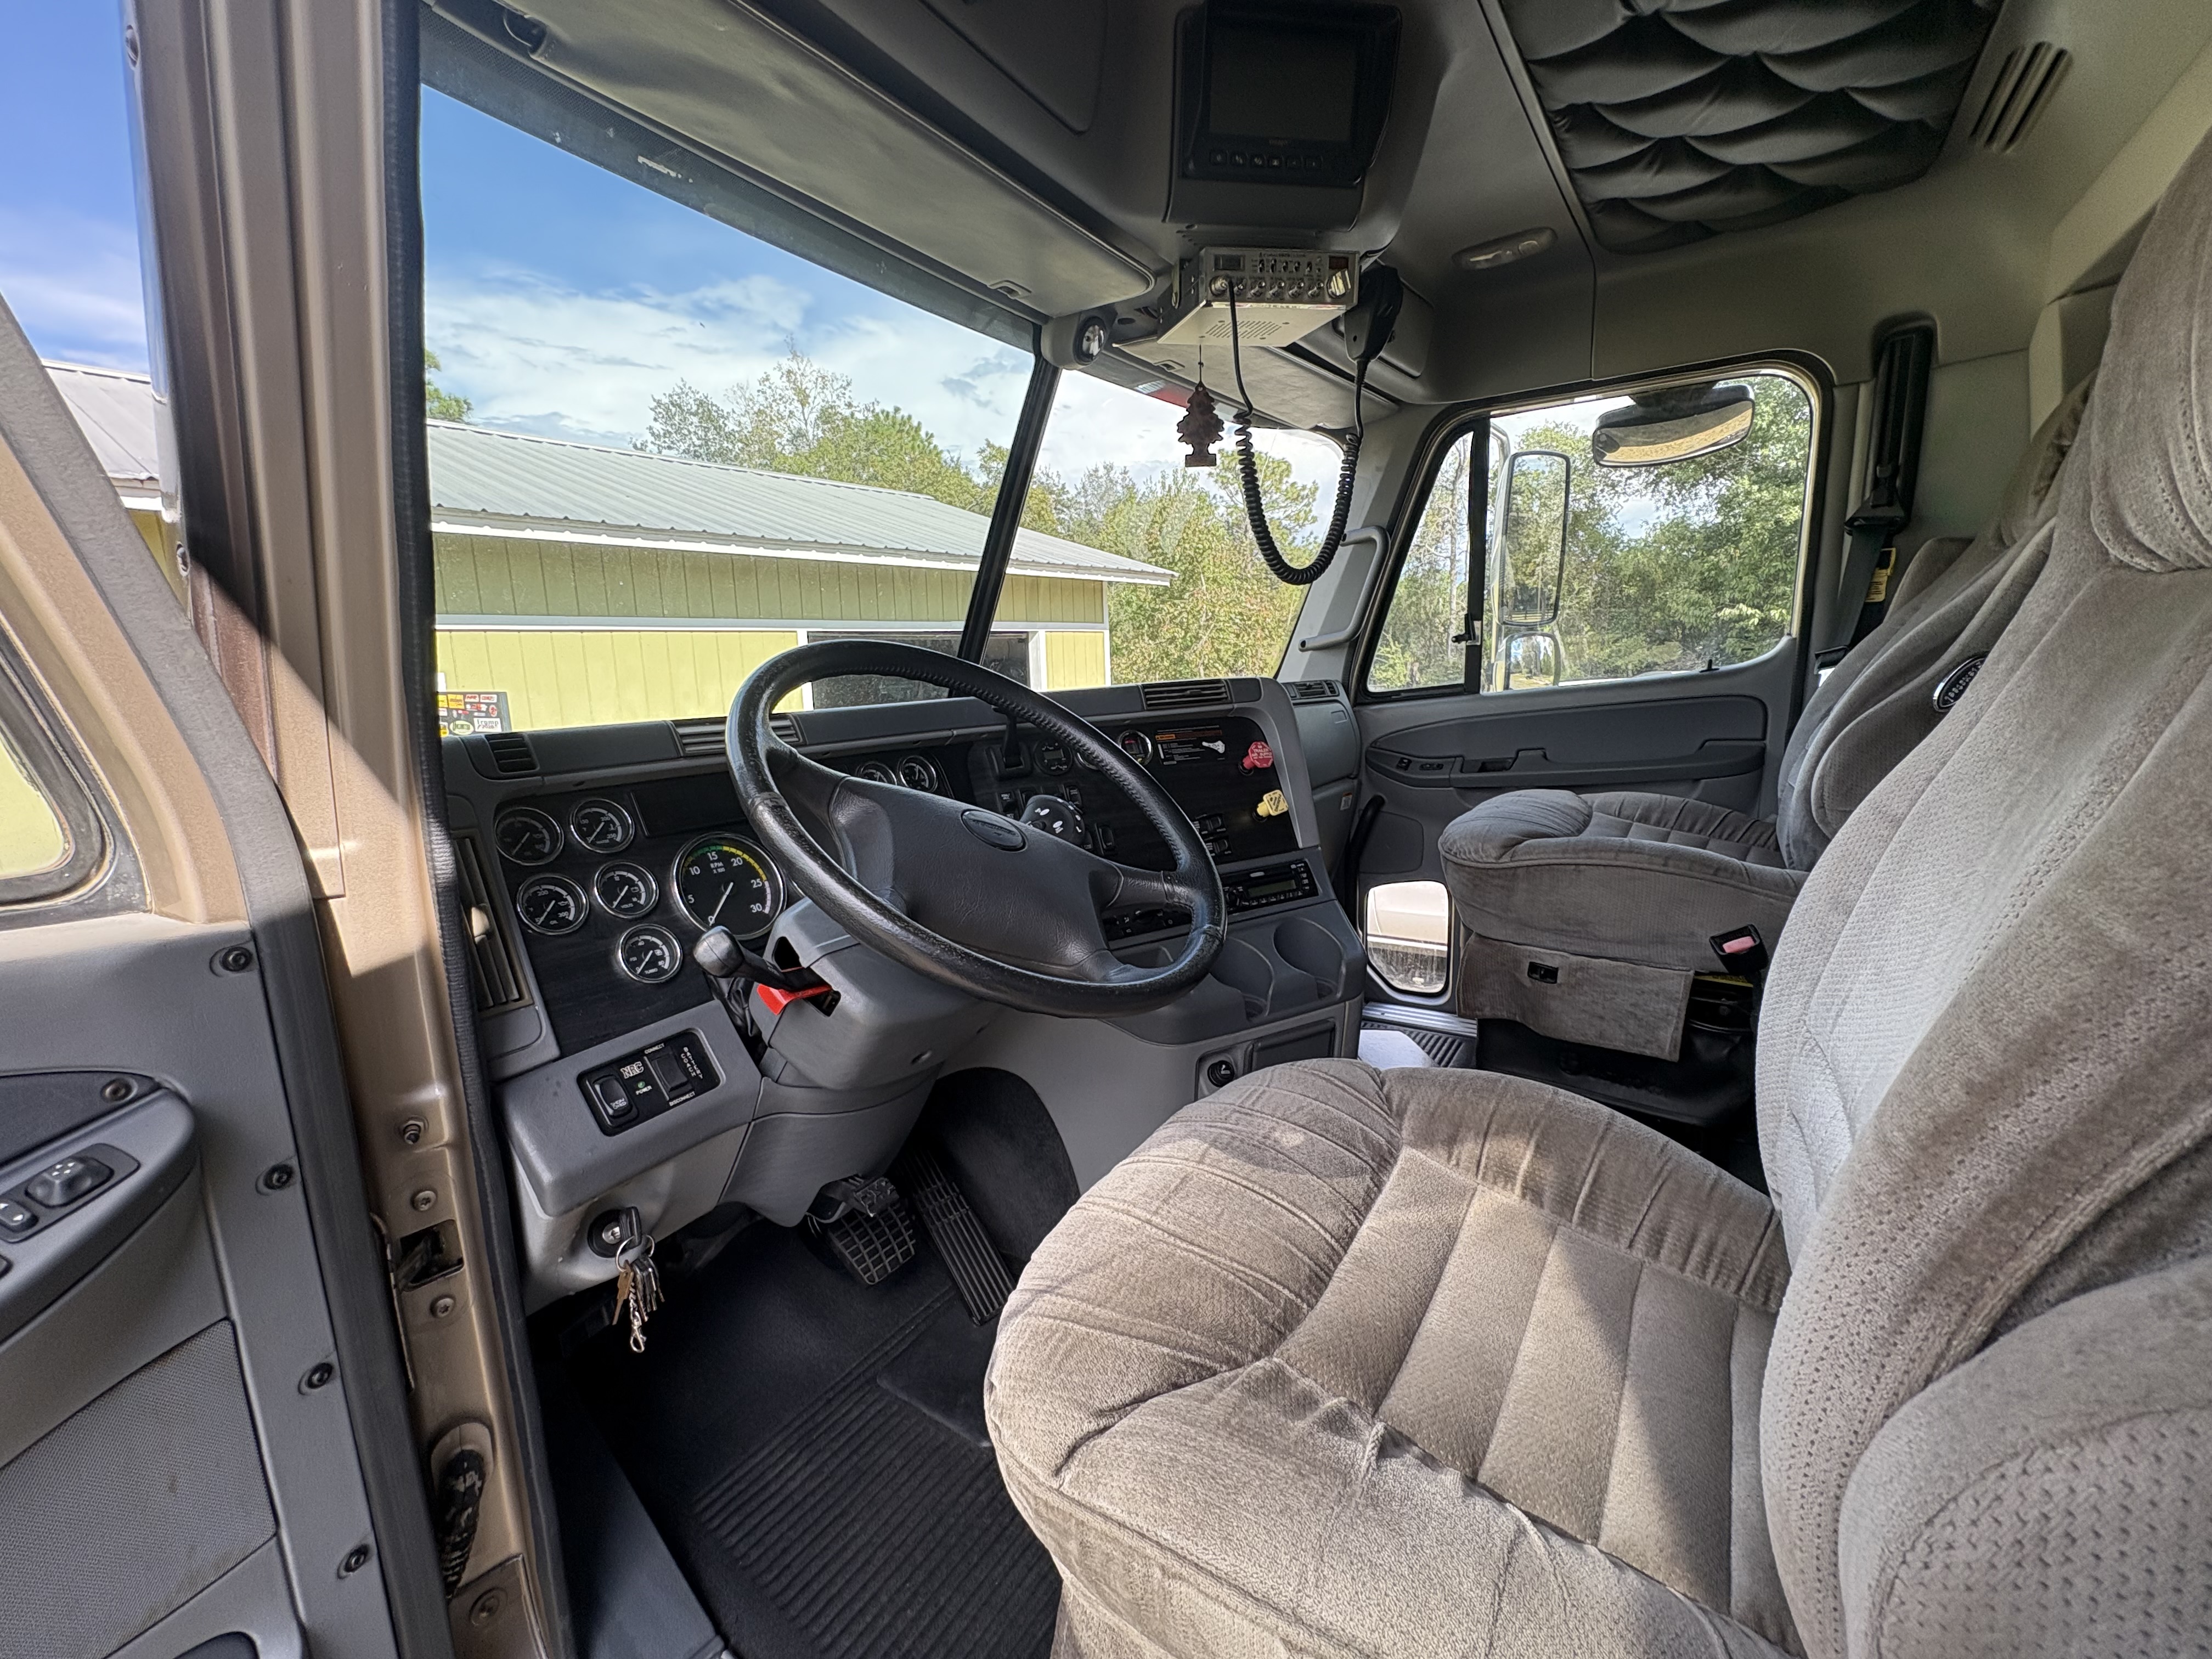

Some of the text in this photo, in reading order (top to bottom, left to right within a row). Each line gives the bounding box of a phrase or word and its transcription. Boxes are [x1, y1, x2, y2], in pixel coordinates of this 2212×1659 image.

[707, 851, 719, 861] 15
[731, 857, 743, 867] 20
[689, 866, 701, 876] 10
[751, 879, 763, 889] 25
[687, 895, 695, 904] 5
[750, 903, 763, 913] 30
[644, 1043, 665, 1054] CONNECT
[680, 1053, 696, 1077] COACH
[684, 1047, 704, 1080] BATTERY
[620, 1060, 644, 1079] NRC
[635, 1085, 653, 1096] POWER
[669, 1091, 696, 1107] DISCONNECT
